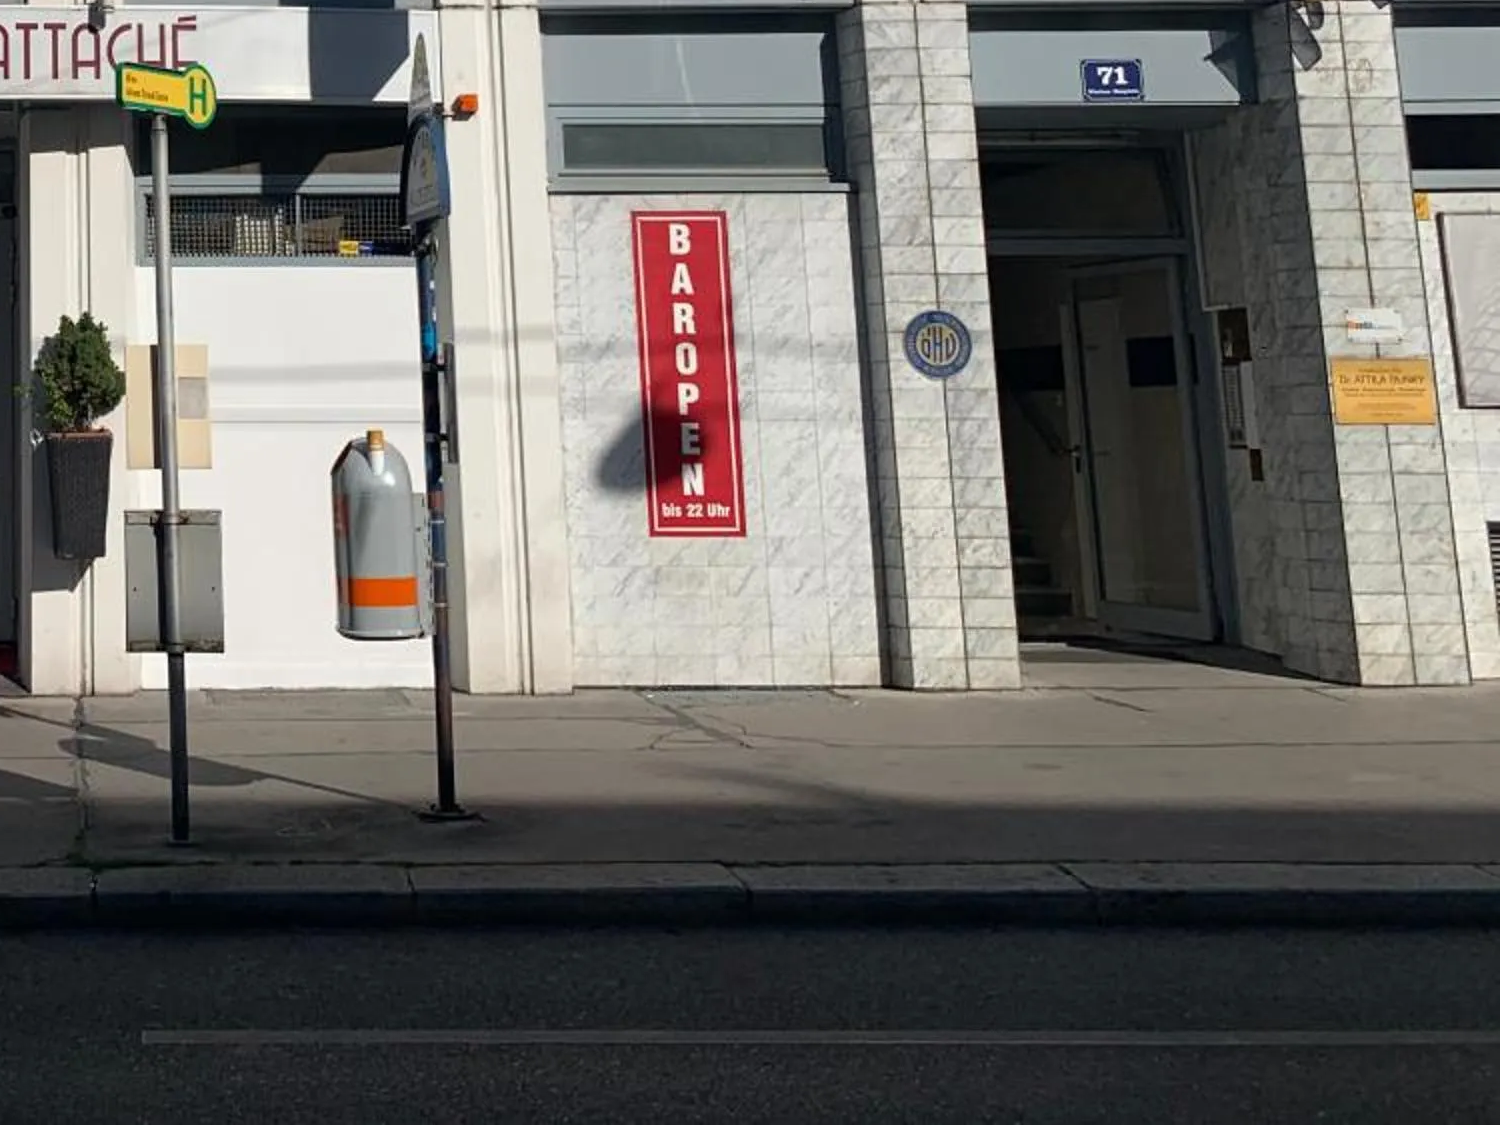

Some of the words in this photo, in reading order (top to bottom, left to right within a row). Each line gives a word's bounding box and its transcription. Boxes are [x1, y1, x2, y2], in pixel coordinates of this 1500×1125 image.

[1096, 66, 1129, 86] 71
[190, 76, 206, 116] H
[661, 502, 682, 518] bis
[685, 503, 704, 518] 22
[707, 502, 730, 518] Uhr
